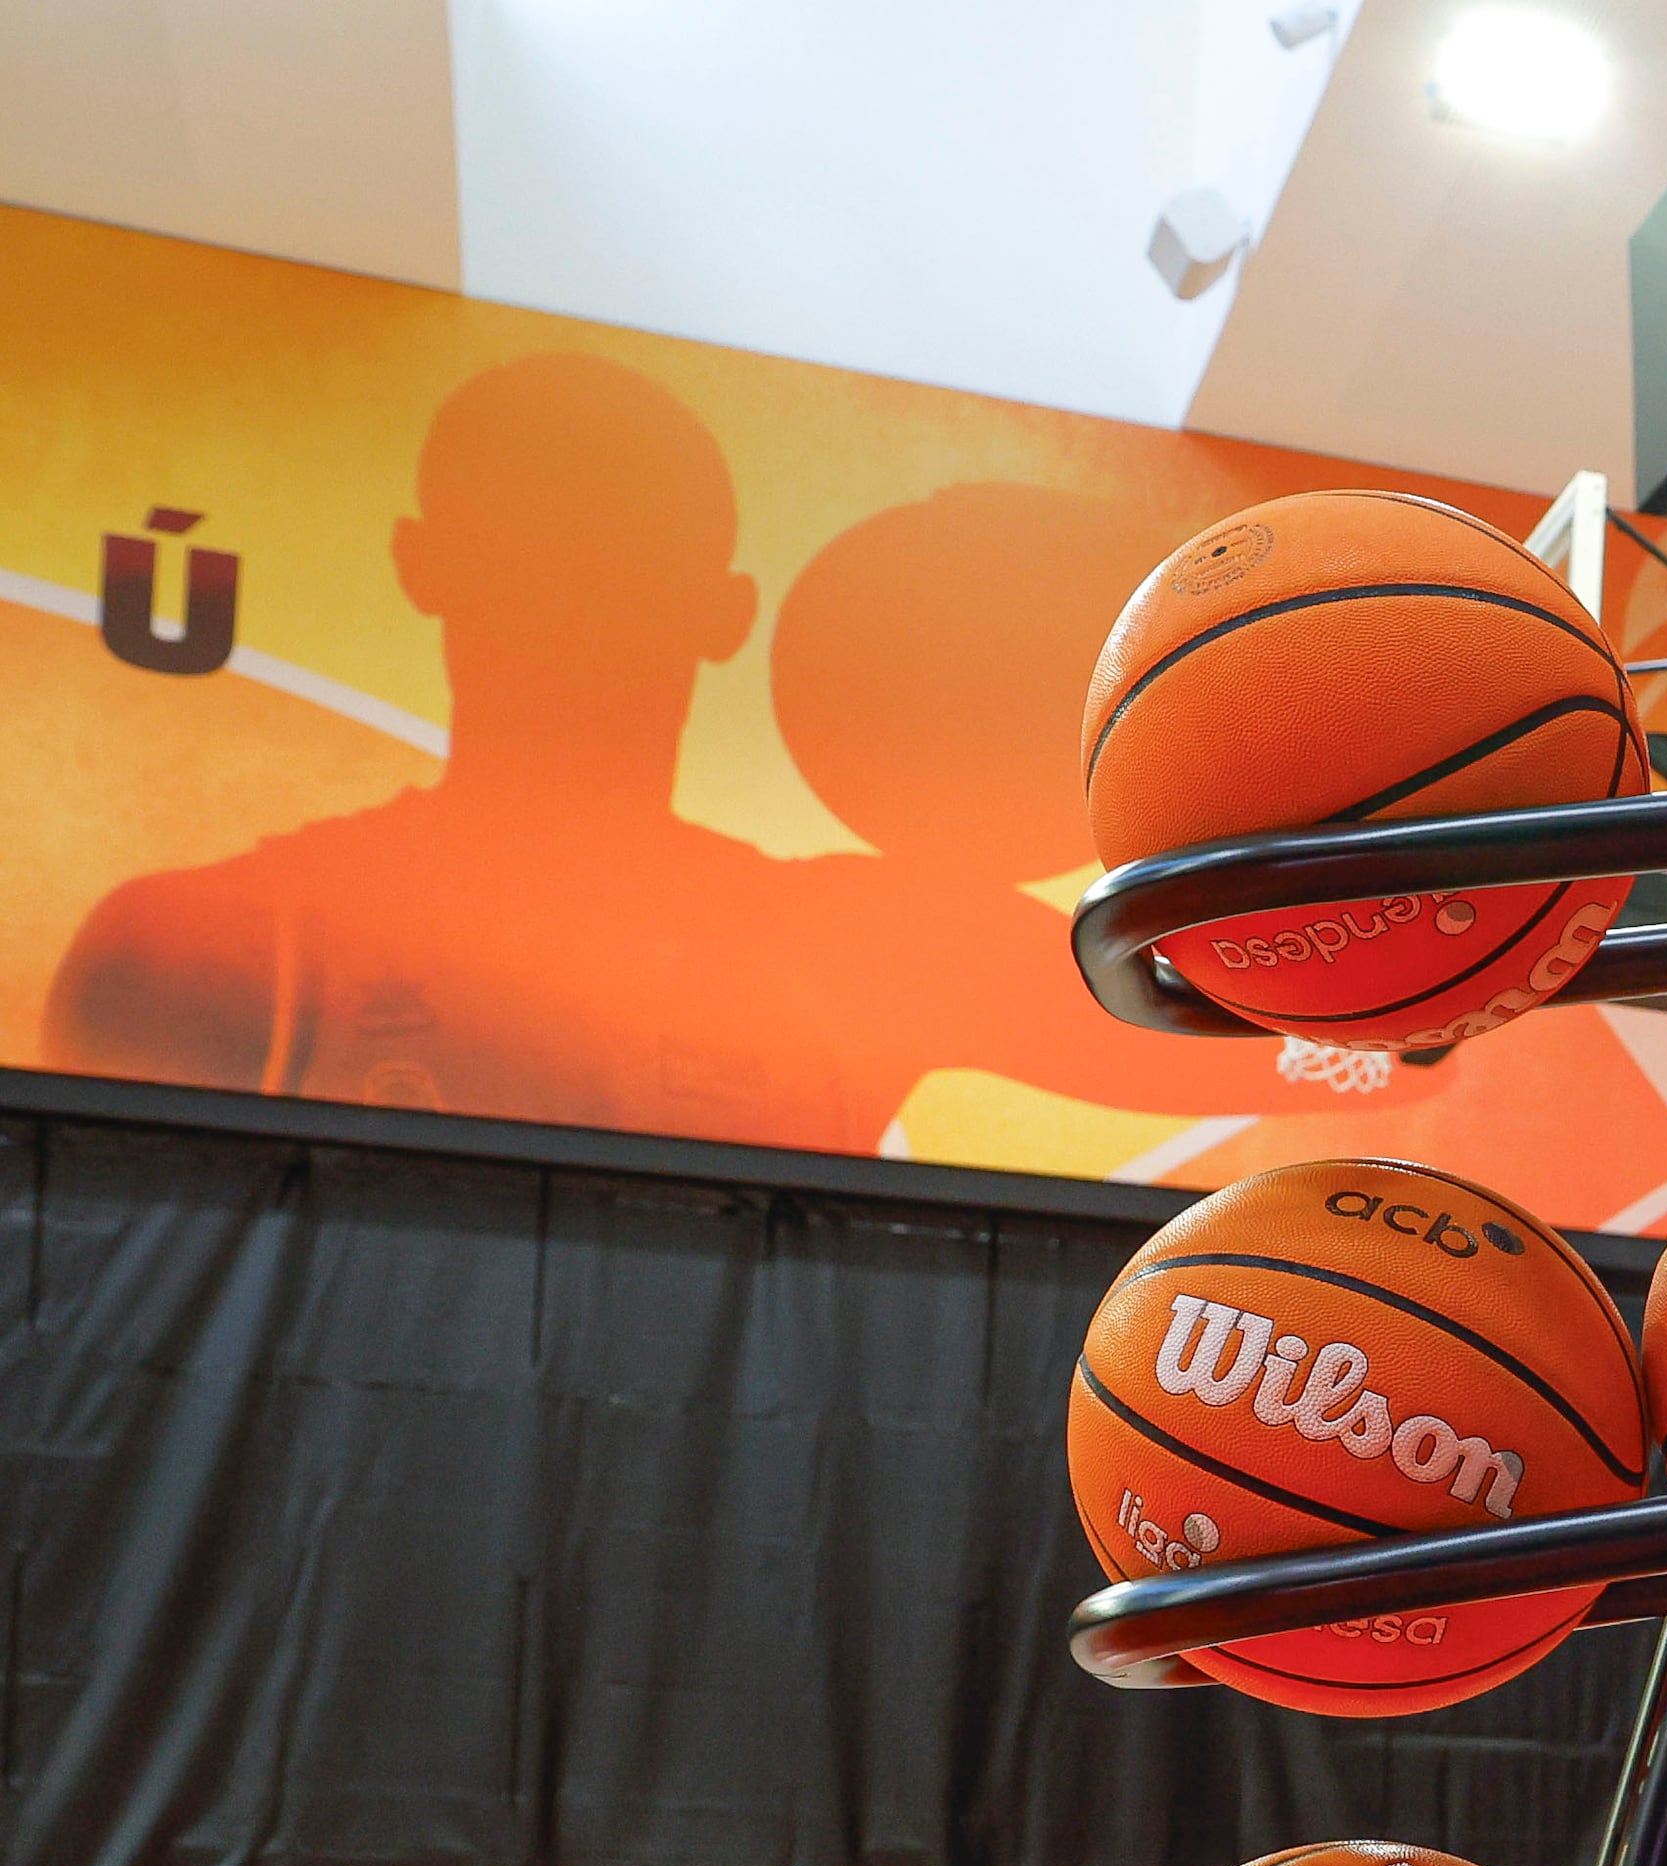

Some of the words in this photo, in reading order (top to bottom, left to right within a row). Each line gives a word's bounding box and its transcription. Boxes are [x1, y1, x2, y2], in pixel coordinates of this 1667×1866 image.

[103, 507, 240, 675] Ú
[1325, 1191, 1481, 1259] acb
[1154, 1293, 1526, 1520] Wilson
